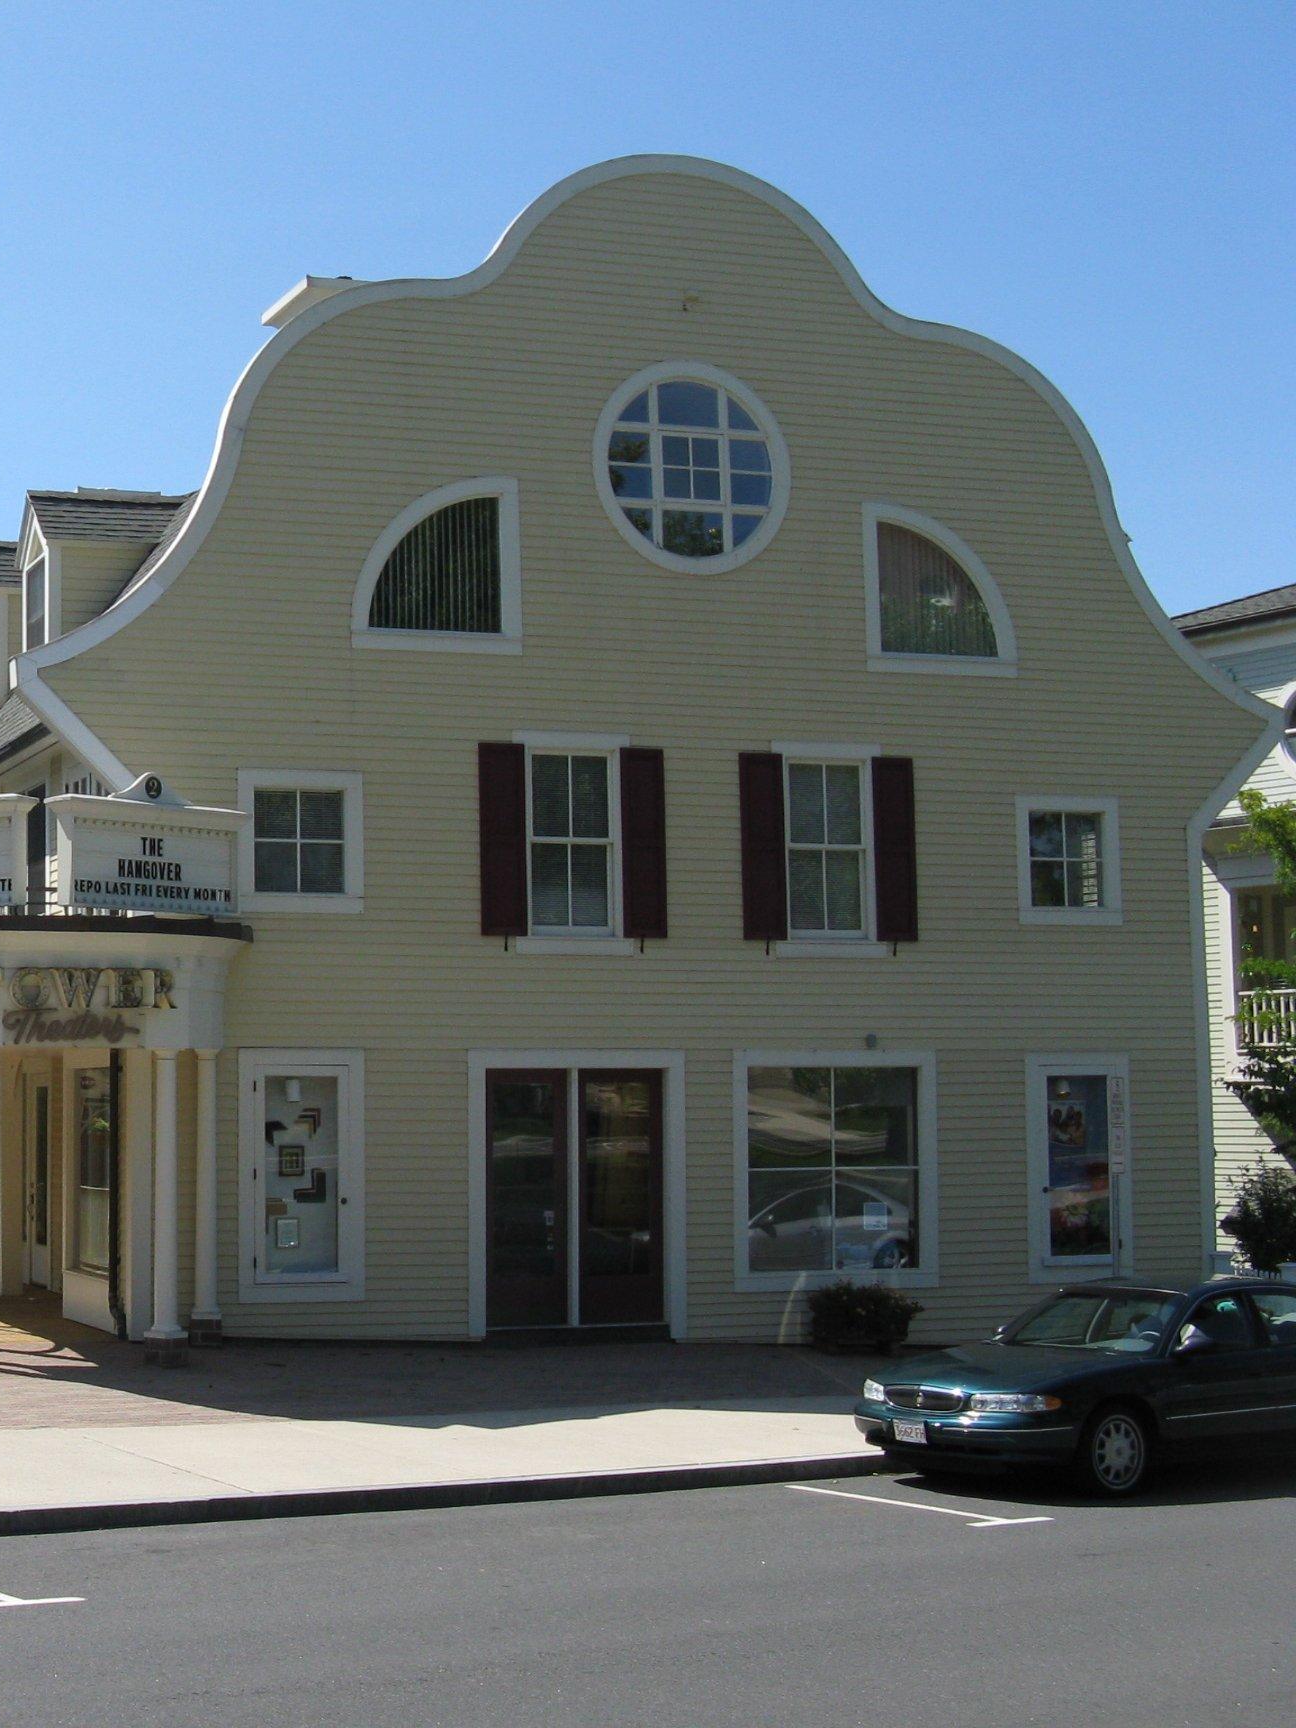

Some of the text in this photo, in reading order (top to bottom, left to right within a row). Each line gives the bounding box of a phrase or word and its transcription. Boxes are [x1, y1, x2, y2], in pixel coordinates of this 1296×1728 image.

[141, 837, 163, 857] THE
[118, 859, 182, 881] HANGOVER
[105, 881, 132, 896] LAST
[135, 883, 153, 897] FRI
[156, 885, 190, 899] EVERY
[193, 887, 232, 902] MONTH
